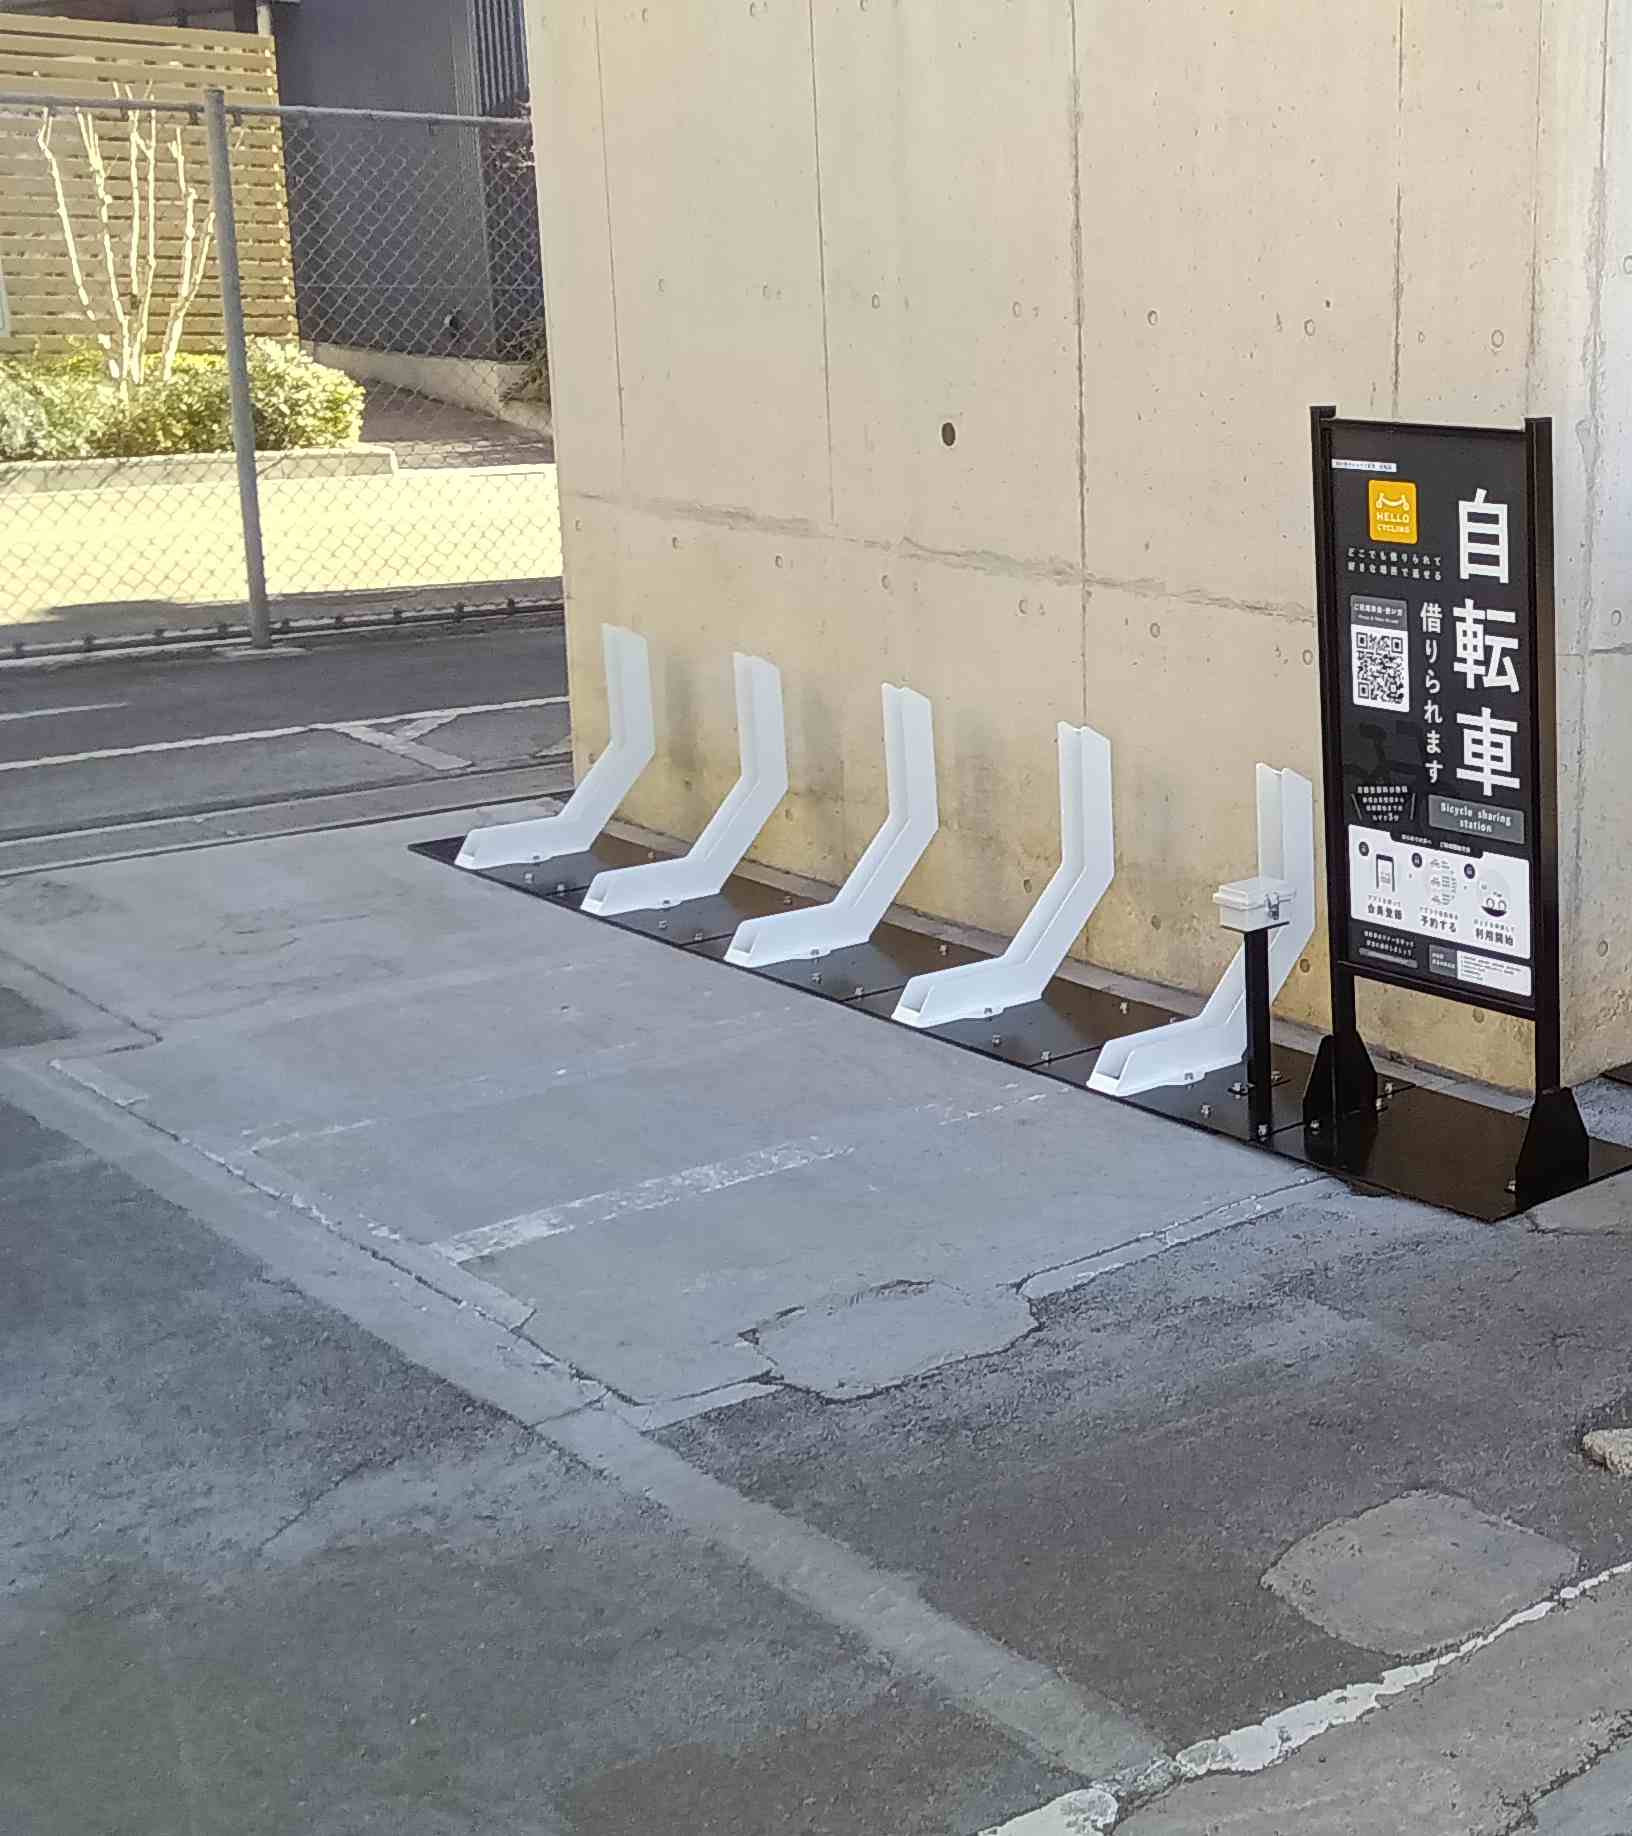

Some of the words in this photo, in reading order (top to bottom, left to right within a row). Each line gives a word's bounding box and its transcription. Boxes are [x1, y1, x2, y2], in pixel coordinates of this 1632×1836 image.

[1376, 511, 1410, 523] HELLO
[1453, 488, 1520, 796] 自転車
[1420, 602, 1443, 783] 借りられます
[1440, 802, 1473, 817] Bicycle
[1478, 809, 1512, 827] sharing
[1459, 819, 1493, 833] station
[1367, 904, 1402, 921] 会員登録
[1420, 914, 1457, 933] 予約する
[1475, 926, 1514, 946] 利用開始
